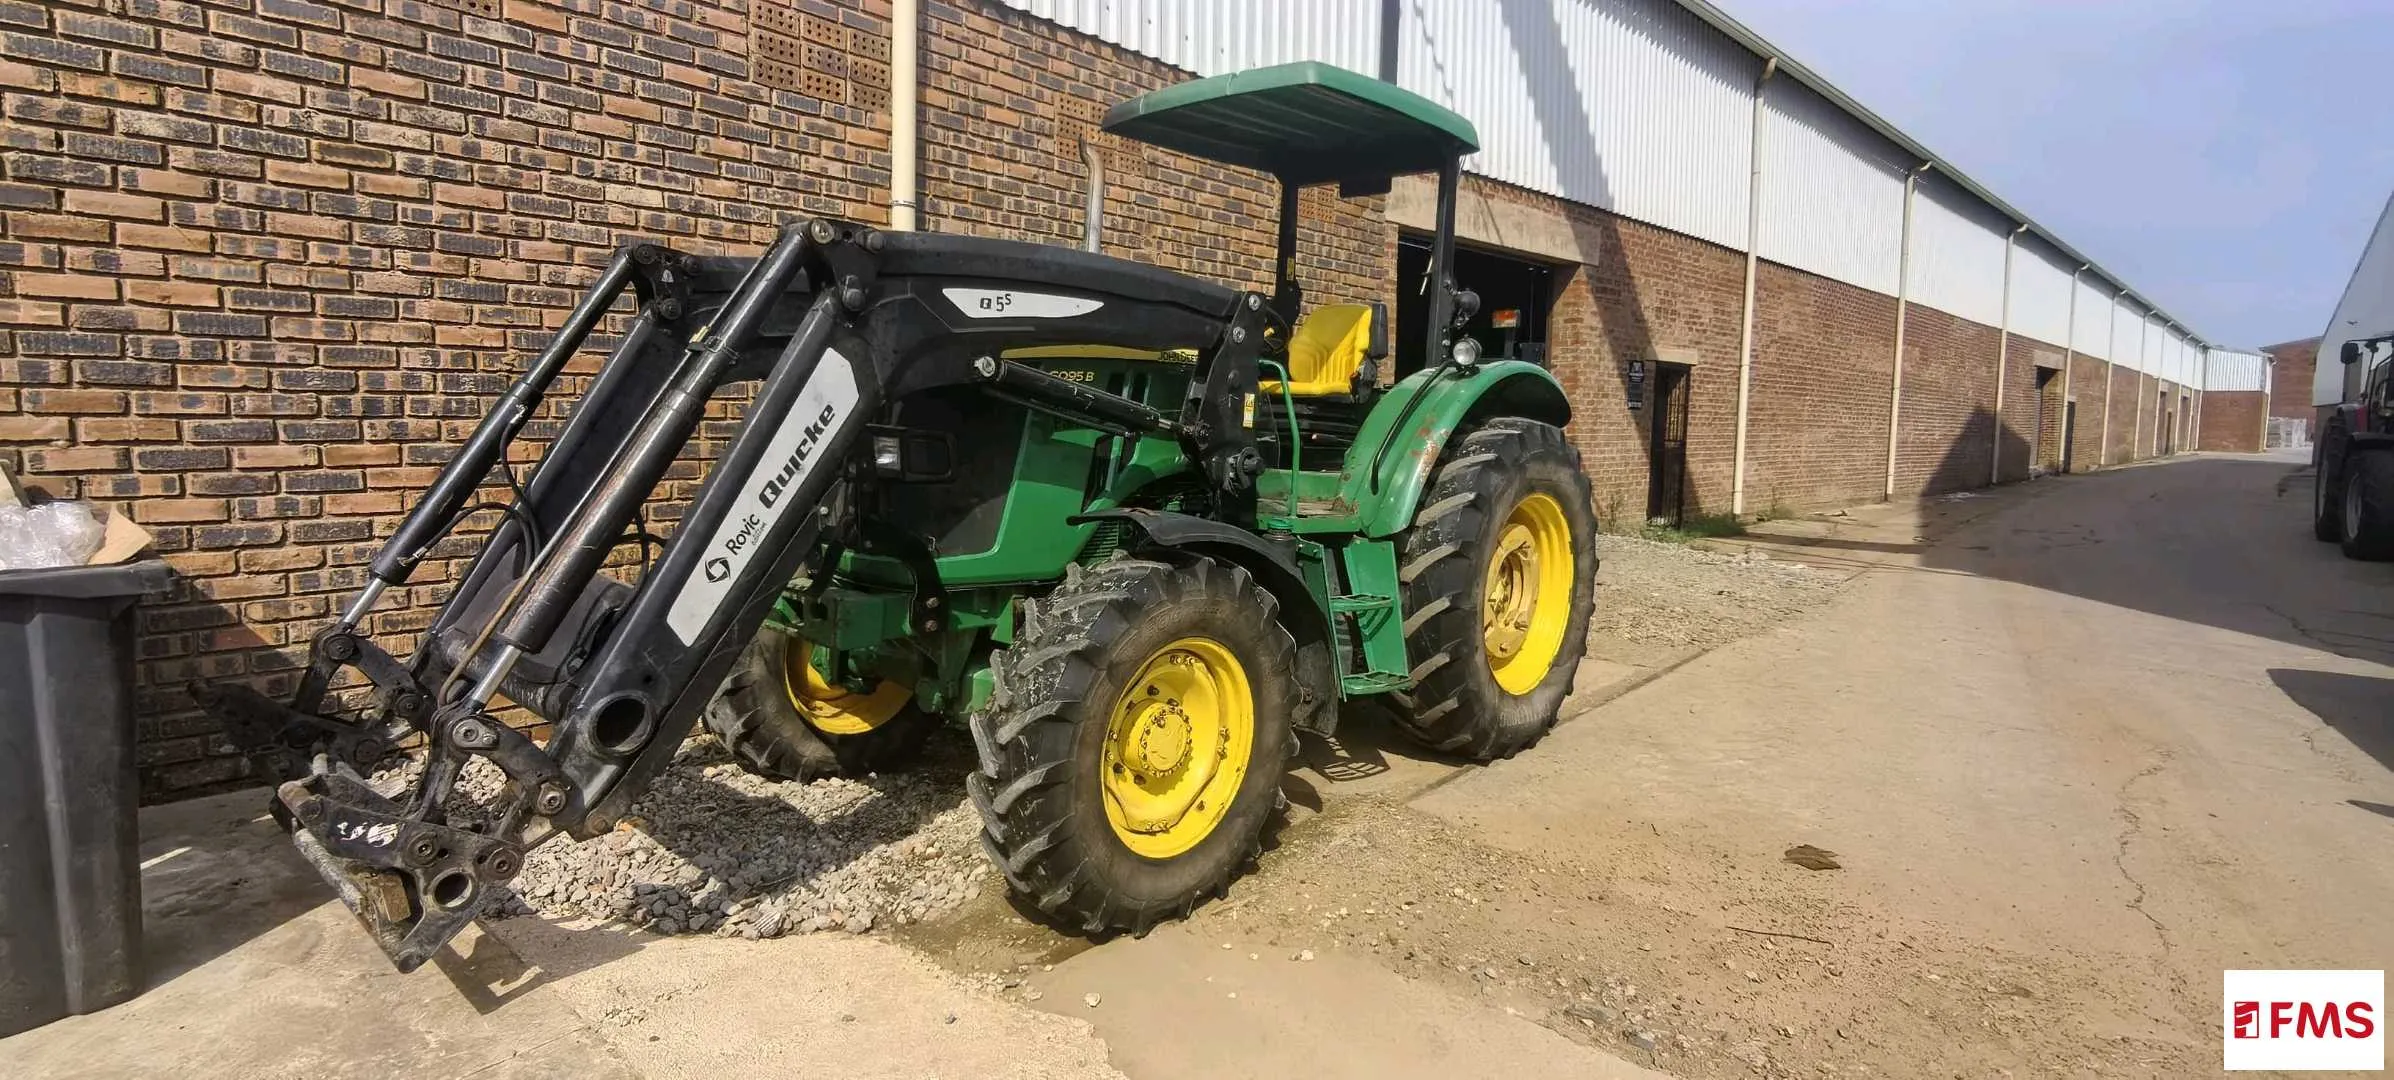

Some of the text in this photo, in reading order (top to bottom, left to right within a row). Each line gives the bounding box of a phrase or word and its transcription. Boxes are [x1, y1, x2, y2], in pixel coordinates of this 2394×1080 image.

[1158, 351, 1180, 362] JOHN
[1085, 371, 1095, 382] B
[725, 404, 836, 556] Rovic Quicke
